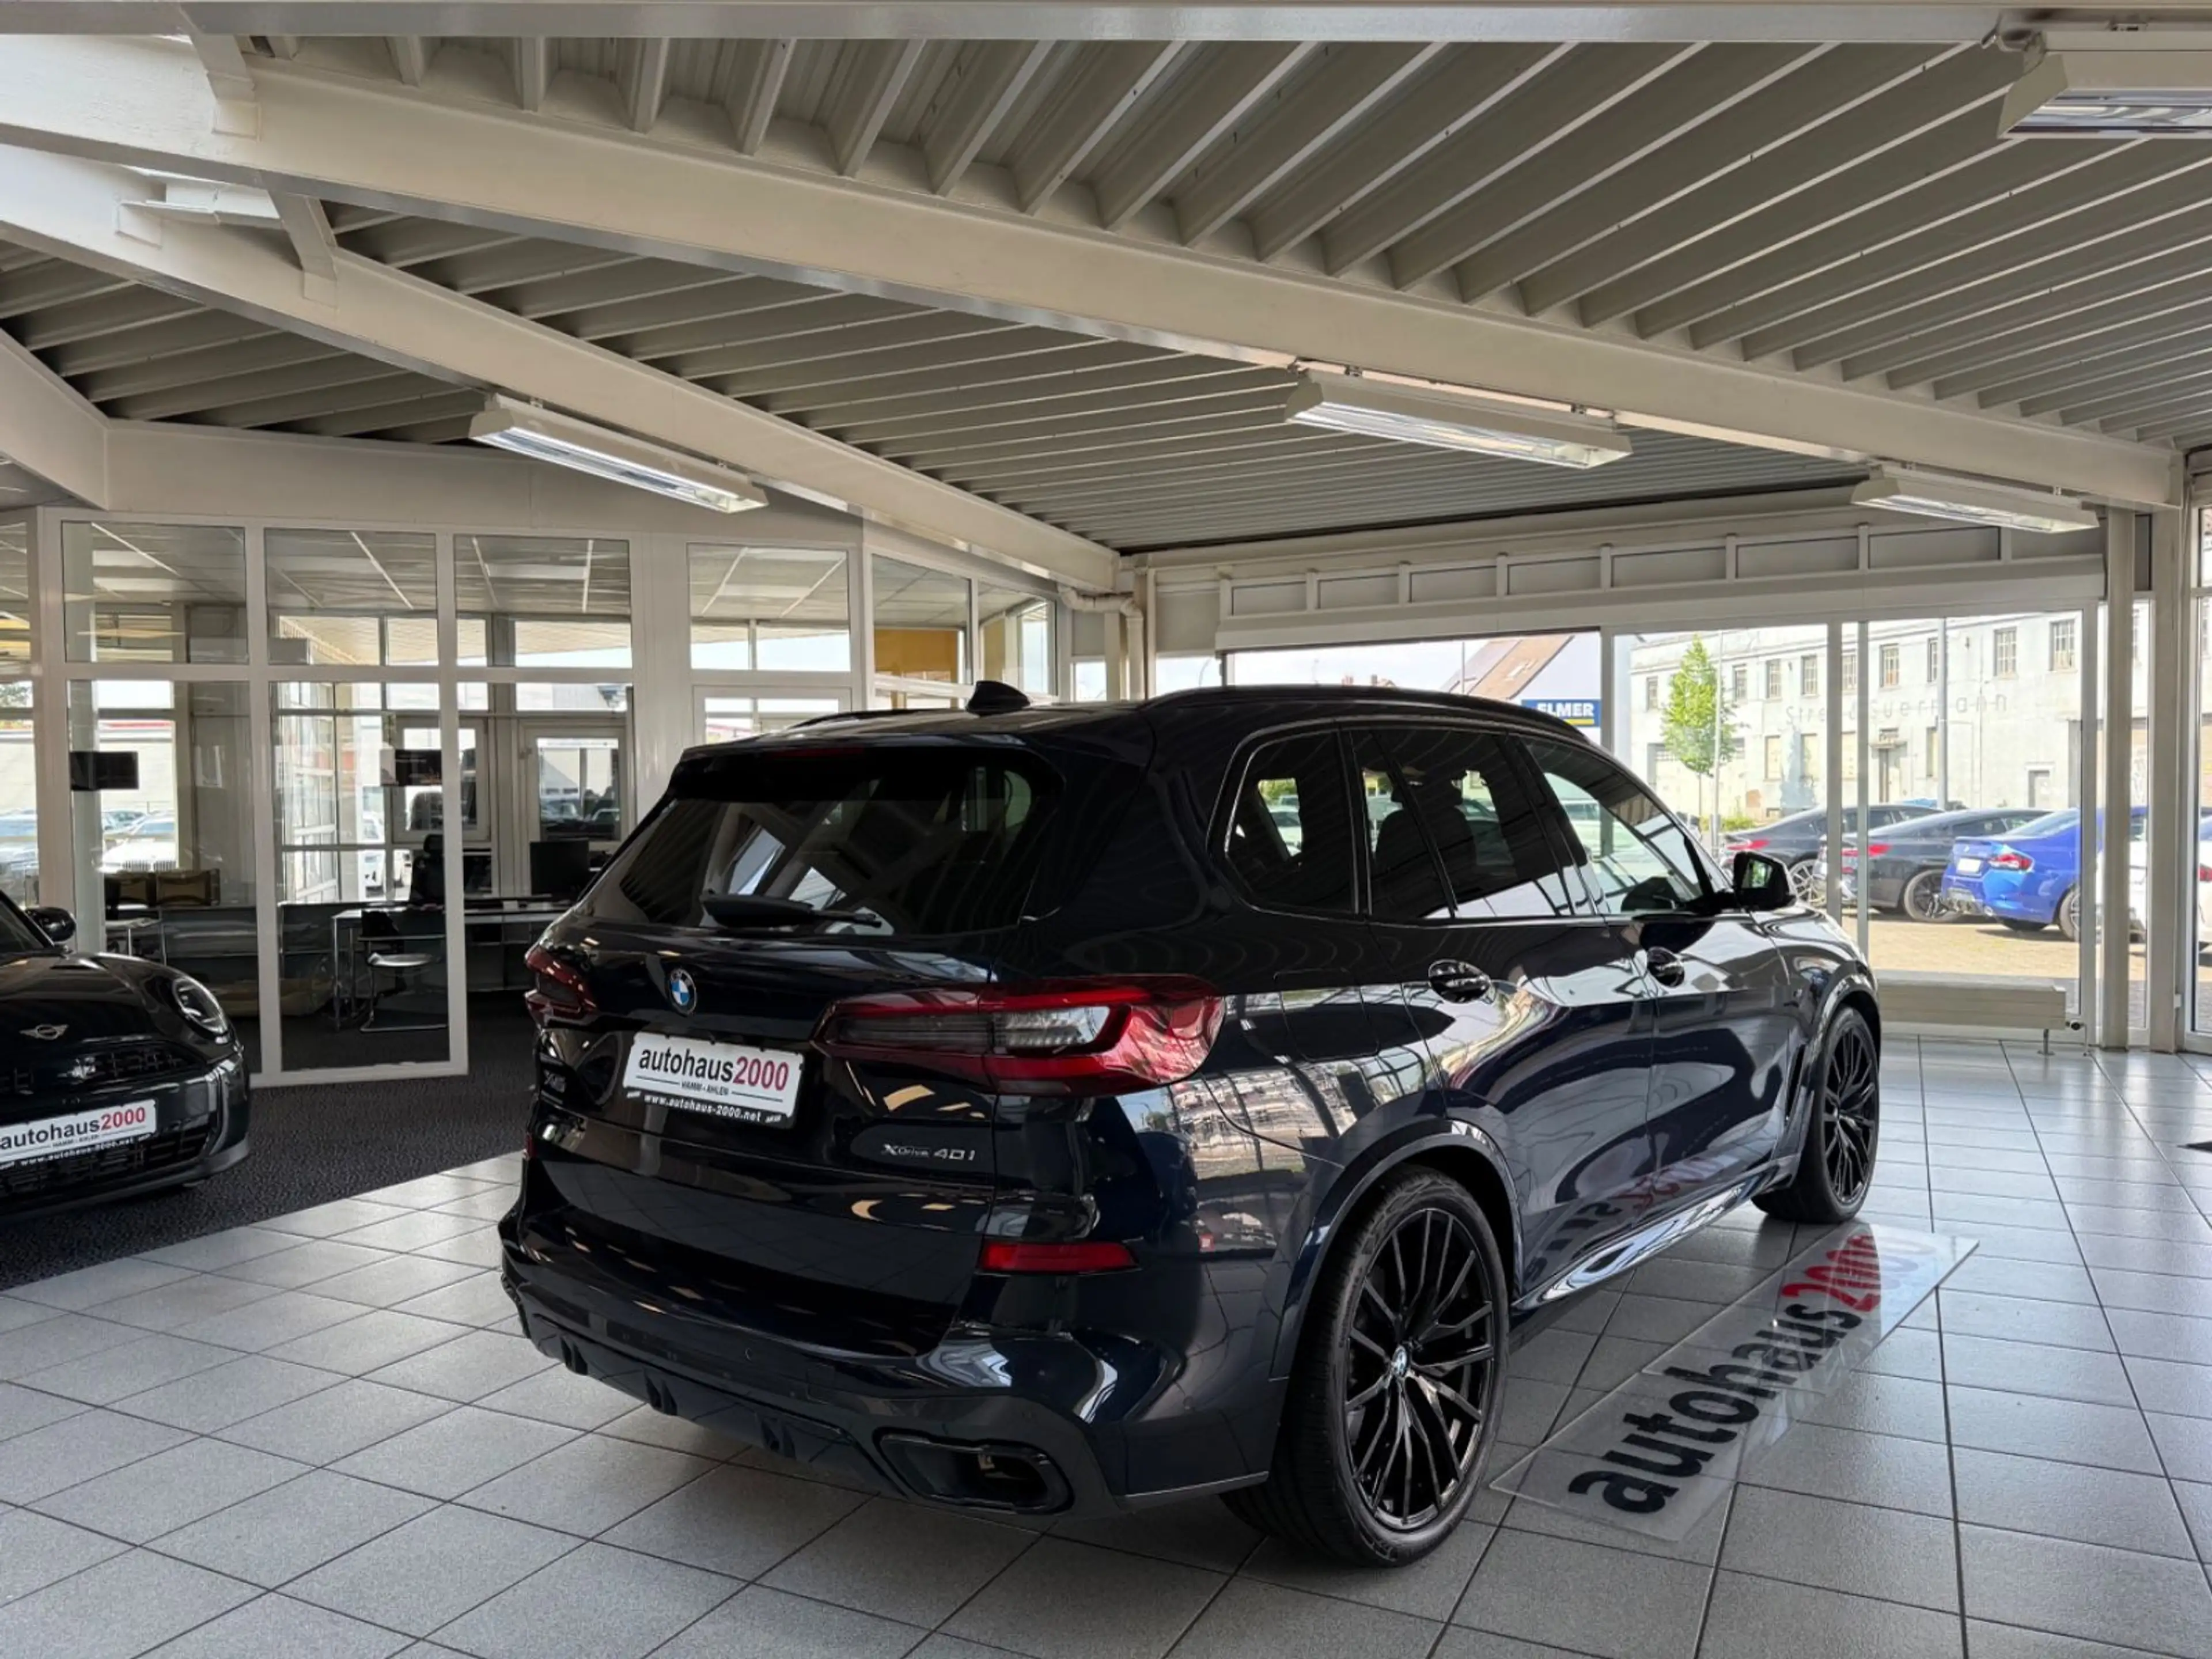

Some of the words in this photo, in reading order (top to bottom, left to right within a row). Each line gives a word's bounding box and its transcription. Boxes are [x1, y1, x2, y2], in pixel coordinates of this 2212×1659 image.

[639, 1048, 789, 1091] autohaus2000
[0, 1107, 145, 1150] autohaus2000
[643, 1095, 762, 1122] www.autohaus-2000.net
[1568, 1234, 1933, 1513] autohaus2000
